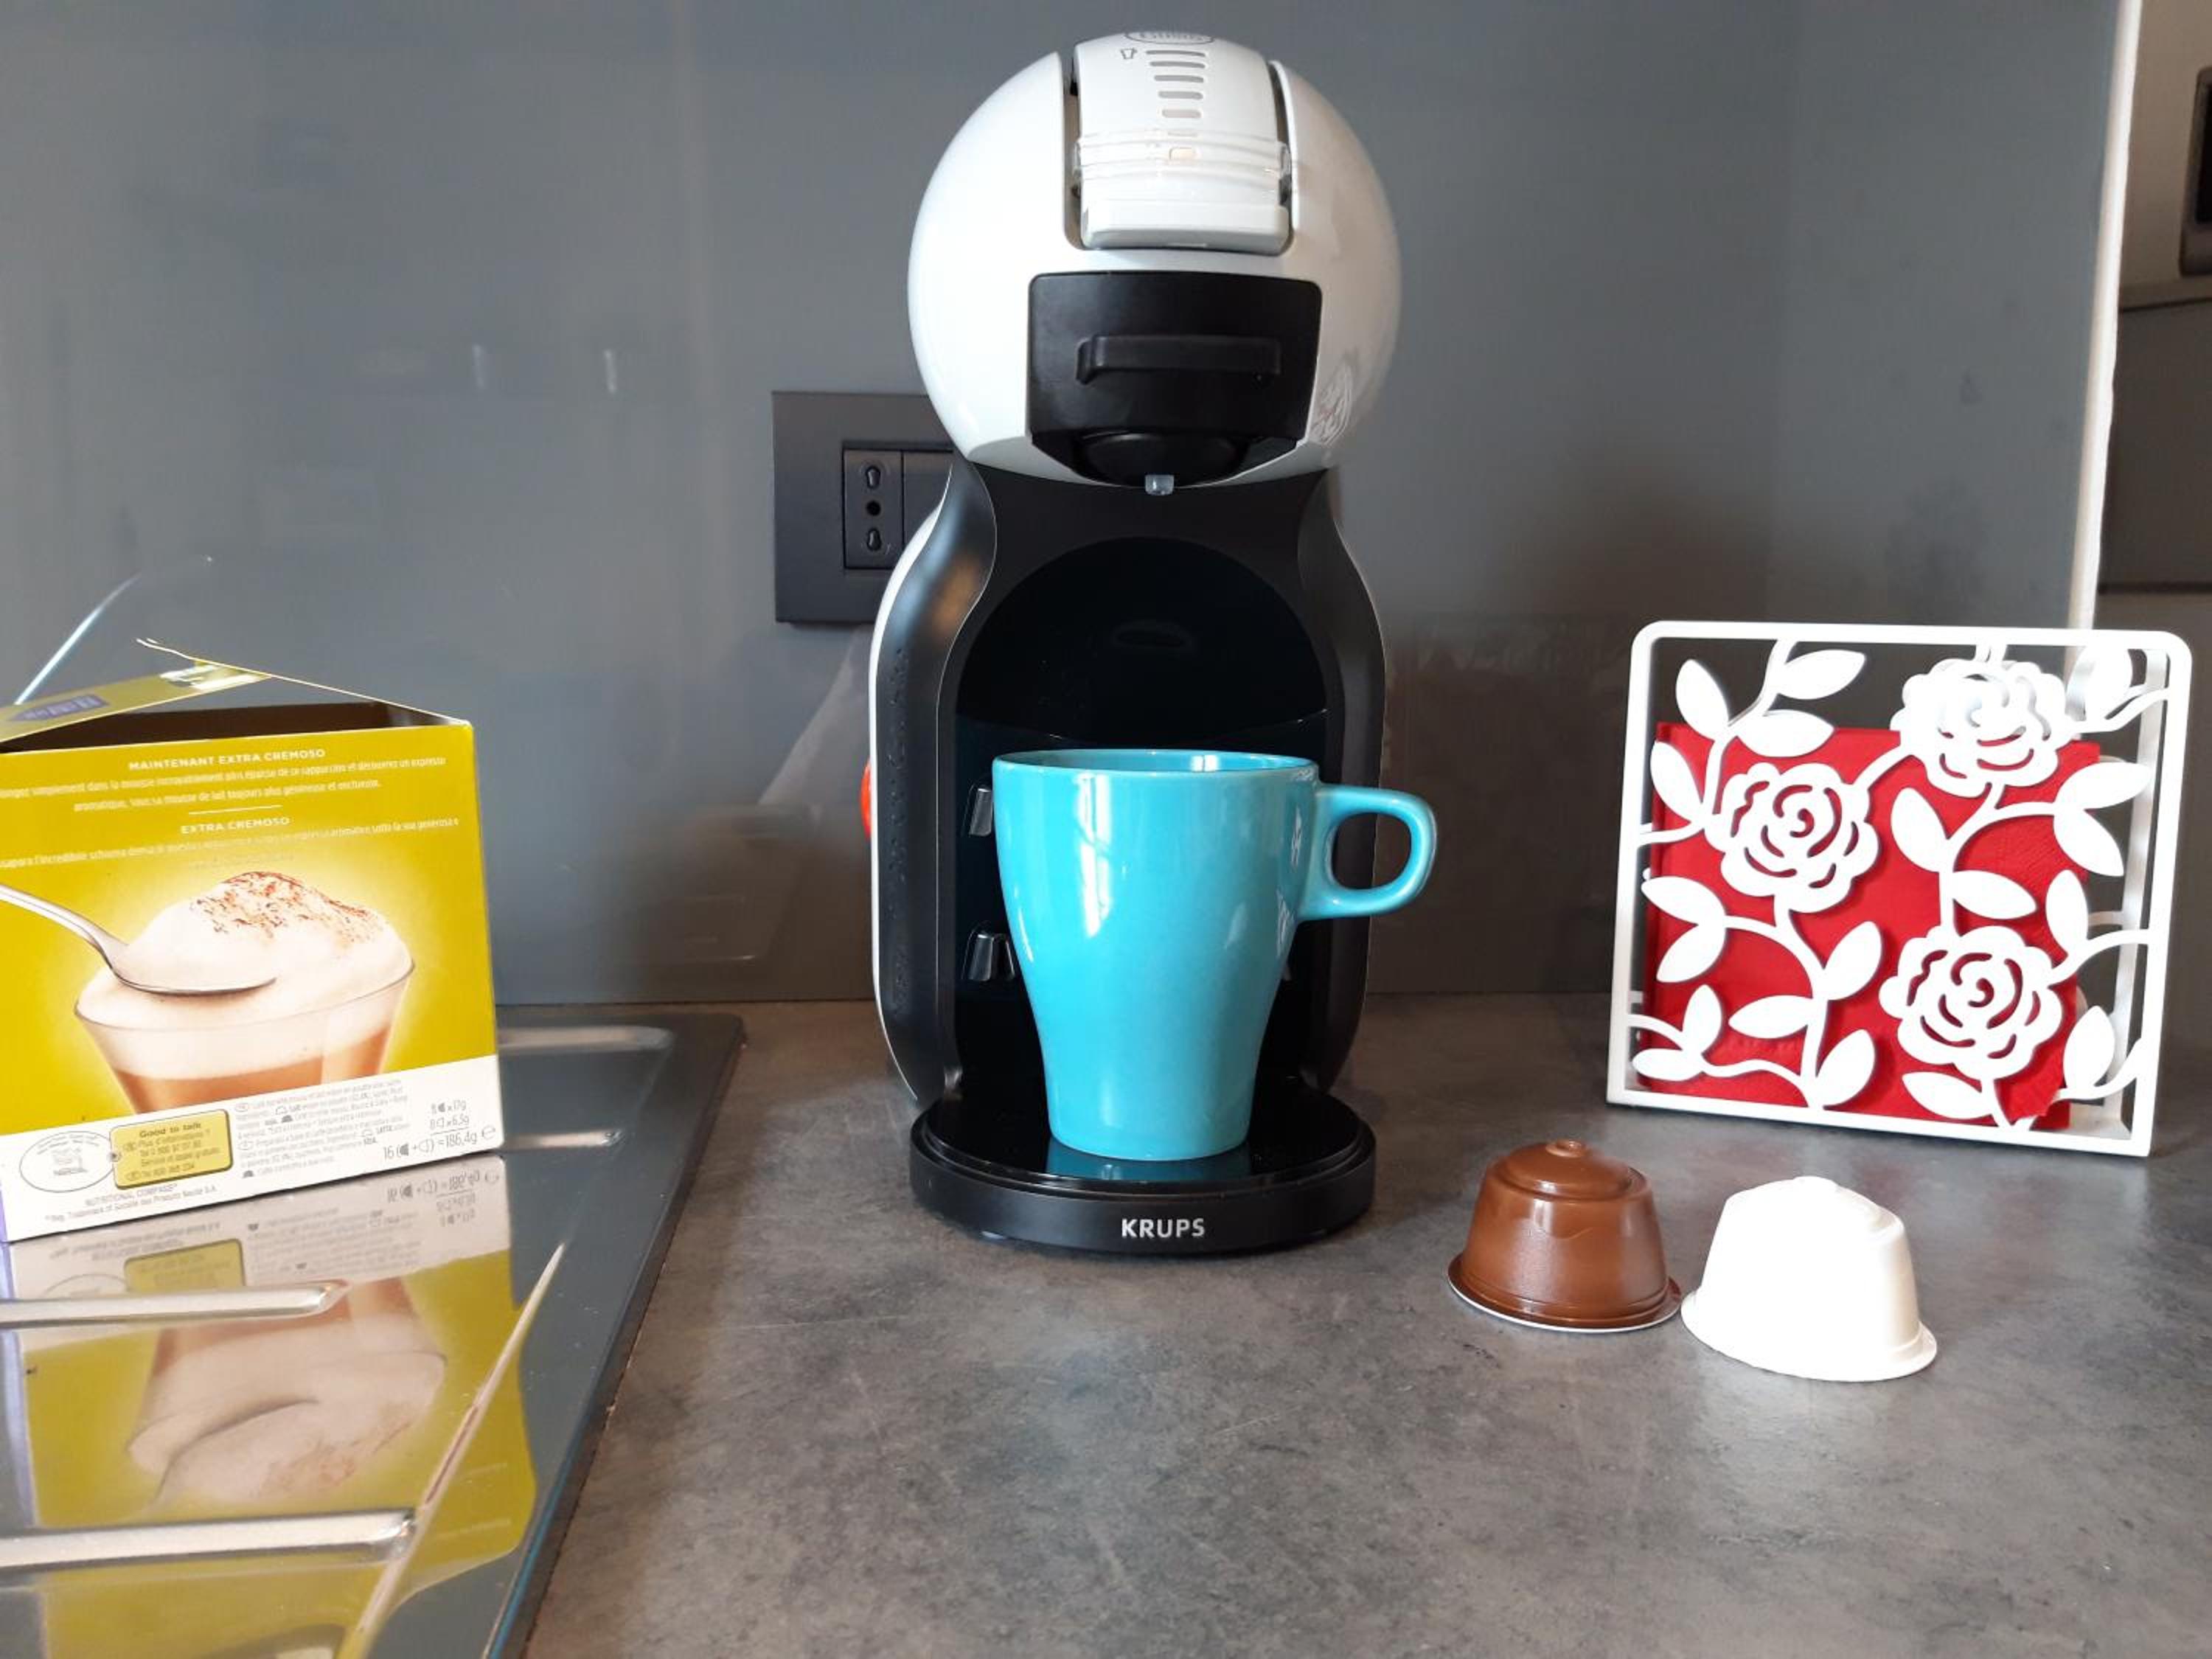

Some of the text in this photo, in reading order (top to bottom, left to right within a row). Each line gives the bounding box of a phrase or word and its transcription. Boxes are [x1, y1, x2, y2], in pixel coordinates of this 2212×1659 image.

[129, 748, 326, 771] MAINTENANT EXTRA CREMOSO
[181, 816, 291, 835] EXTRA CREMOSO
[139, 1128, 166, 1138] Good
[182, 1121, 201, 1132] talk
[1121, 1218, 1205, 1238] KRUPS
